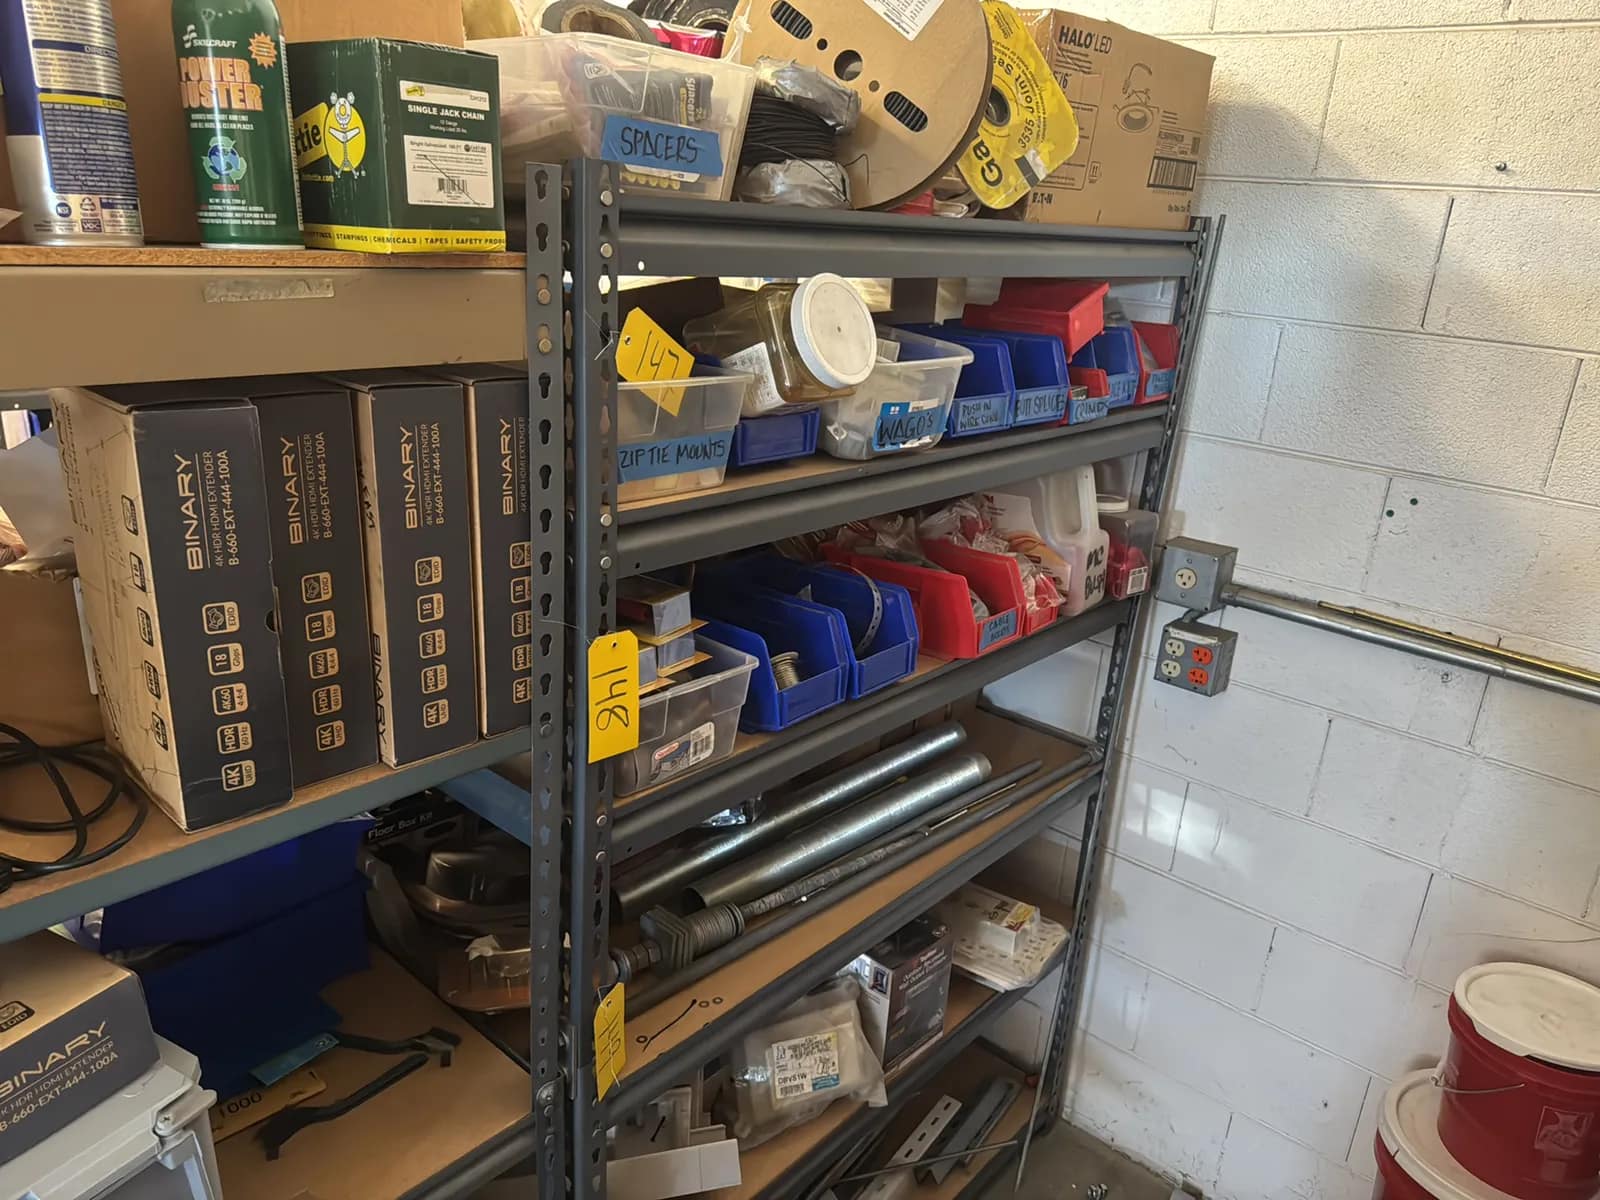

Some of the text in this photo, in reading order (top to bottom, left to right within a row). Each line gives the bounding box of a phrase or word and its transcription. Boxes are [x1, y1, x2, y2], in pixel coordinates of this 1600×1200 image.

[192, 39, 237, 48] SKILCRAFT
[1059, 25, 1112, 54] HALO LED
[1015, 74, 1035, 114] Joint
[407, 104, 485, 120] SINGLE JACK CHAIN
[621, 126, 698, 163] SPACERS
[1018, 118, 1035, 148] 3535
[336, 233, 369, 242] STAMPINGS
[373, 235, 417, 244] CHEMICALS
[636, 329, 680, 402] 147
[303, 433, 315, 480] EXTENDER
[620, 436, 725, 469] ZIP TIE MOUNTS
[400, 426, 418, 529] BINARY
[500, 418, 513, 515] BINARY
[280, 437, 304, 545] BINARY
[315, 431, 333, 538] B-660-EXT-444-100A
[174, 453, 204, 570] BINARY
[203, 451, 224, 567] 4K HDR HDMI EXTENDER
[217, 450, 239, 566] B-660-EXT-444-100A
[515, 584, 524, 596] 18
[227, 606, 235, 626] EDID
[422, 602, 432, 615] 18
[311, 620, 322, 633] 18
[214, 653, 227, 667] 18
[427, 669, 436, 692] HDR
[516, 681, 526, 698] 4K
[221, 688, 232, 710] 4K60
[319, 689, 329, 712] HDR
[592, 665, 630, 731] 148
[427, 704, 438, 723] 4K
[224, 727, 236, 750] HDR
[320, 726, 332, 745] 4K
[228, 767, 240, 786] 4K
[368, 825, 396, 840] Floor
[399, 818, 416, 830] Box
[1, 1012, 28, 1030] EDID
[0, 1021, 106, 1099] BINARY
[10, 1092, 33, 1110] HDR
[35, 1074, 63, 1096] HDMI
[65, 1040, 114, 1077] EXTENDER
[0, 1051, 119, 1132] B-660-EXT-444-100A
